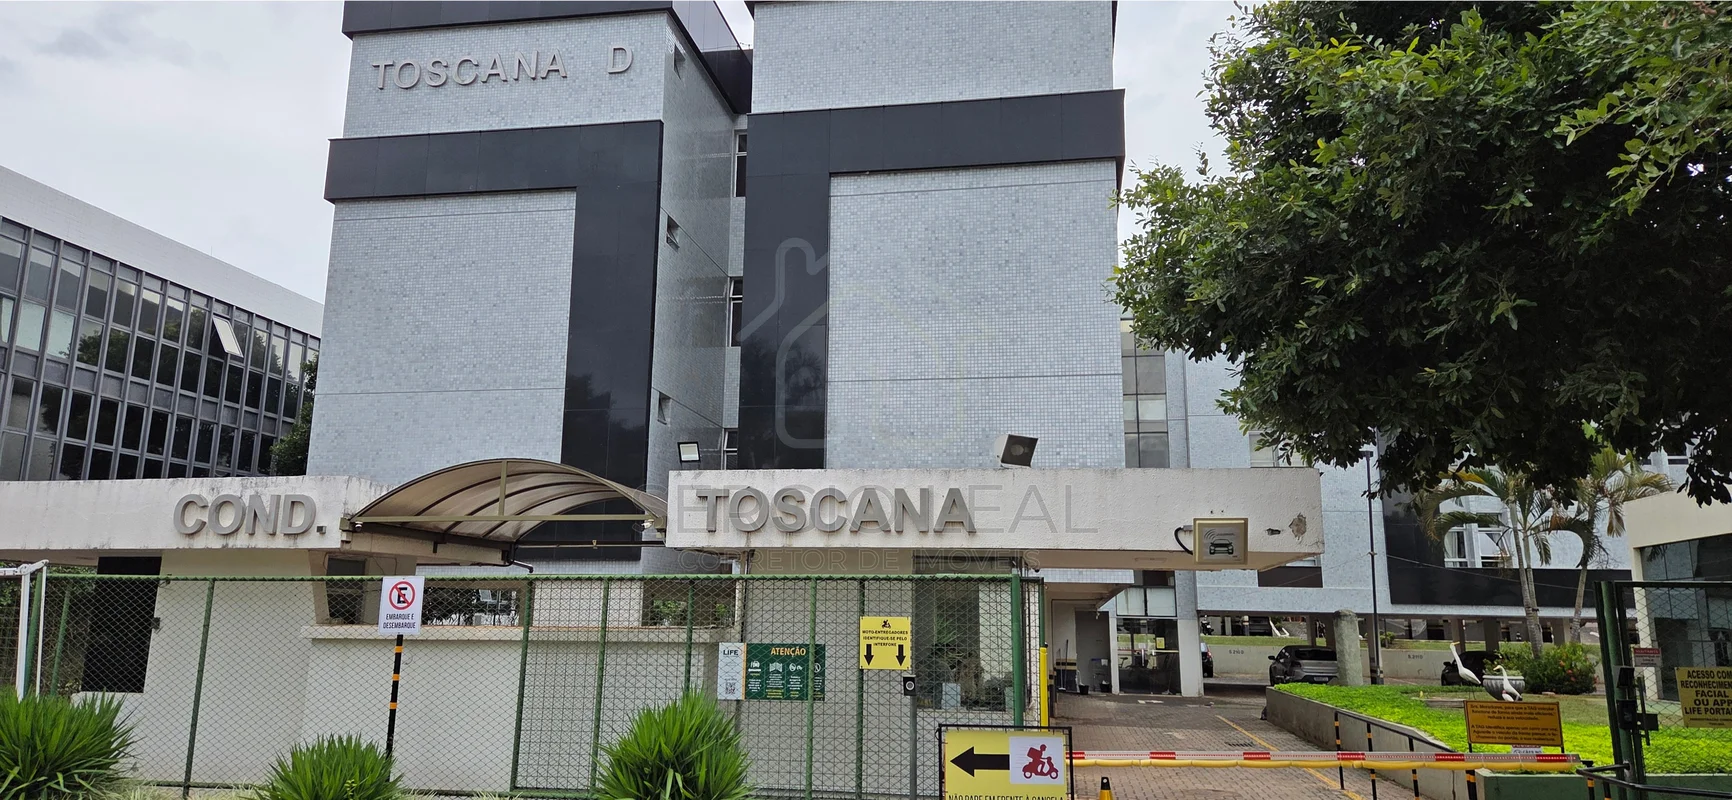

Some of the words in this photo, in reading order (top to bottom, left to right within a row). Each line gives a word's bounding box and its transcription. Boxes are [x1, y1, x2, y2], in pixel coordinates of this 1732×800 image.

[372, 49, 568, 90] TOSCANA
[607, 46, 634, 75] D
[173, 493, 327, 536] COND.
[696, 486, 977, 533] TOSCANA
[397, 587, 408, 604] E
[383, 621, 416, 629] DESEMBARQUE
[770, 646, 806, 657] ATENÇÃO
[1687, 670, 1715, 679] ACESSO
[1716, 670, 1732, 680] COM
[1695, 690, 1729, 698] FACIAL
[1693, 698, 1710, 706] OU
[1684, 707, 1702, 715] LIFE
[1704, 707, 1732, 715] PORTA
